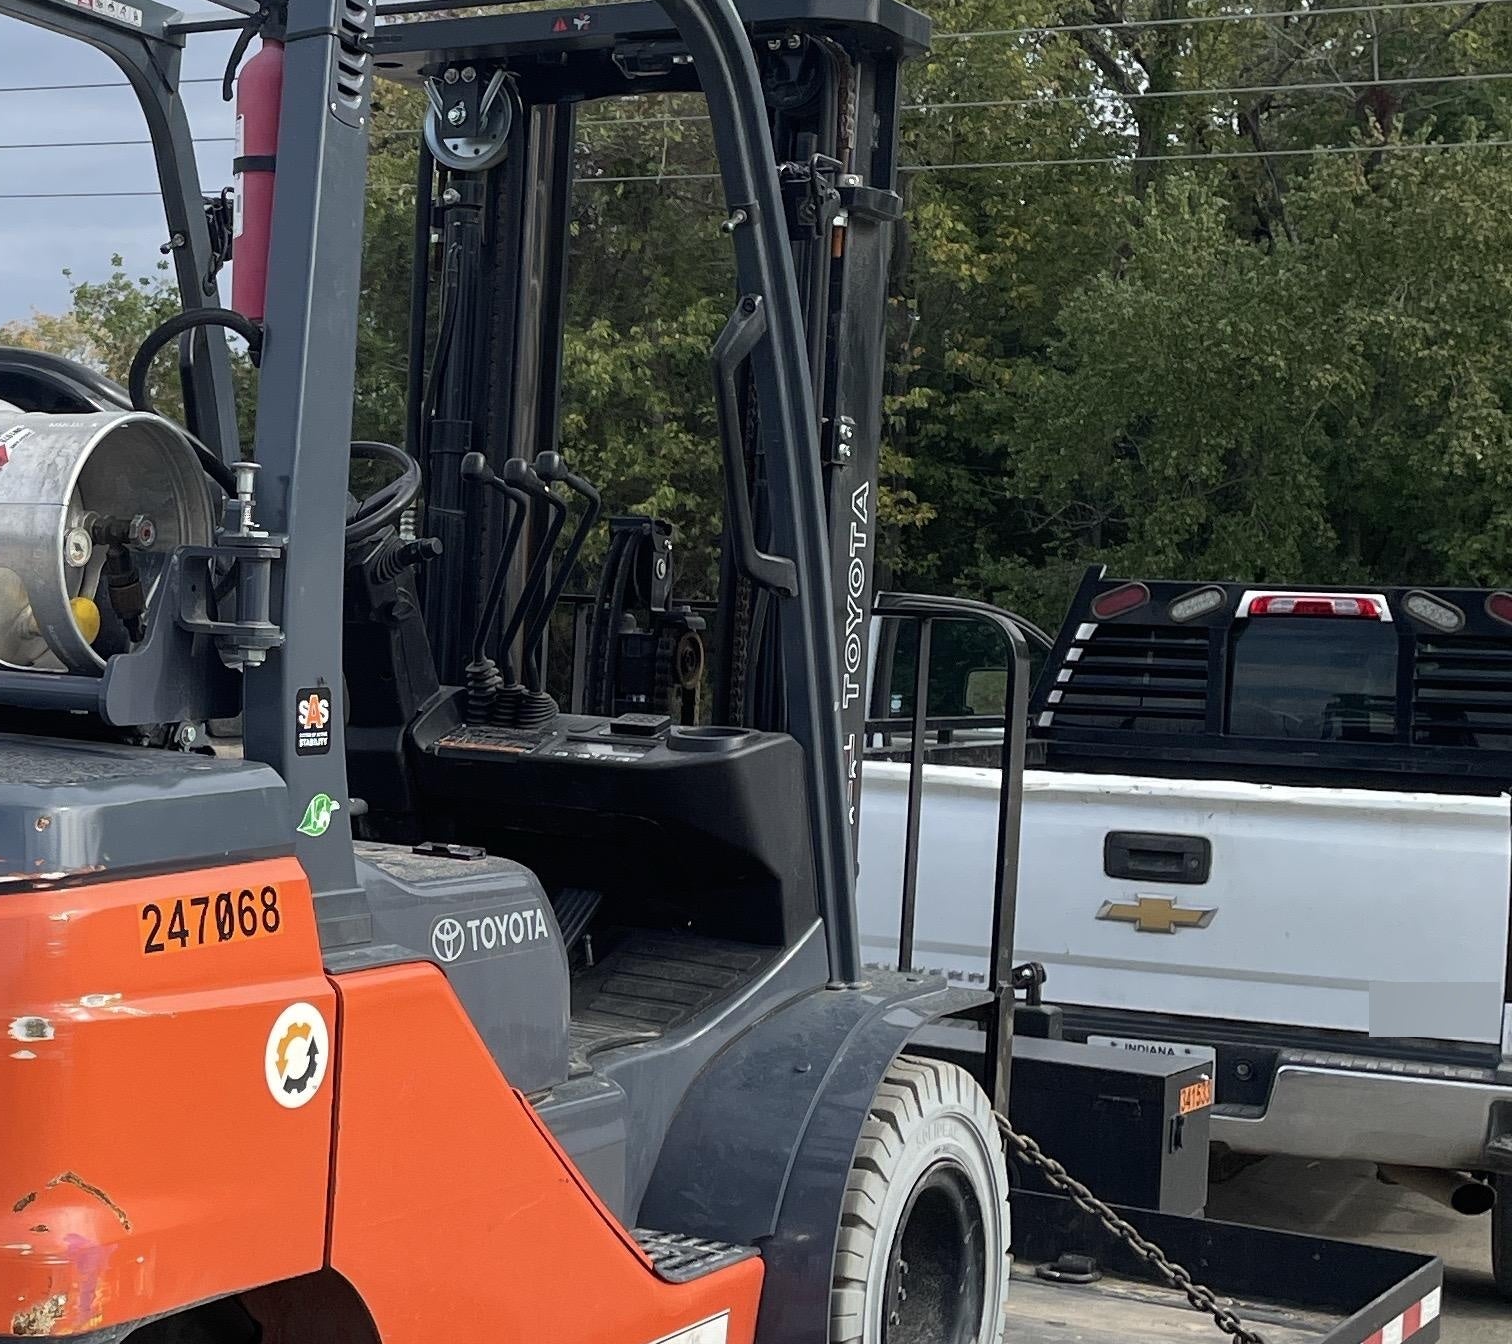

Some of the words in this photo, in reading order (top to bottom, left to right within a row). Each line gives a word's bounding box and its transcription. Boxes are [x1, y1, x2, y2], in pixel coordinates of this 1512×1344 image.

[841, 481, 869, 709] TOYOTA
[298, 694, 329, 729] SAS
[142, 885, 280, 954] 247068
[467, 908, 549, 951] TOYOTA
[1124, 1042, 1176, 1056] INDIANA
